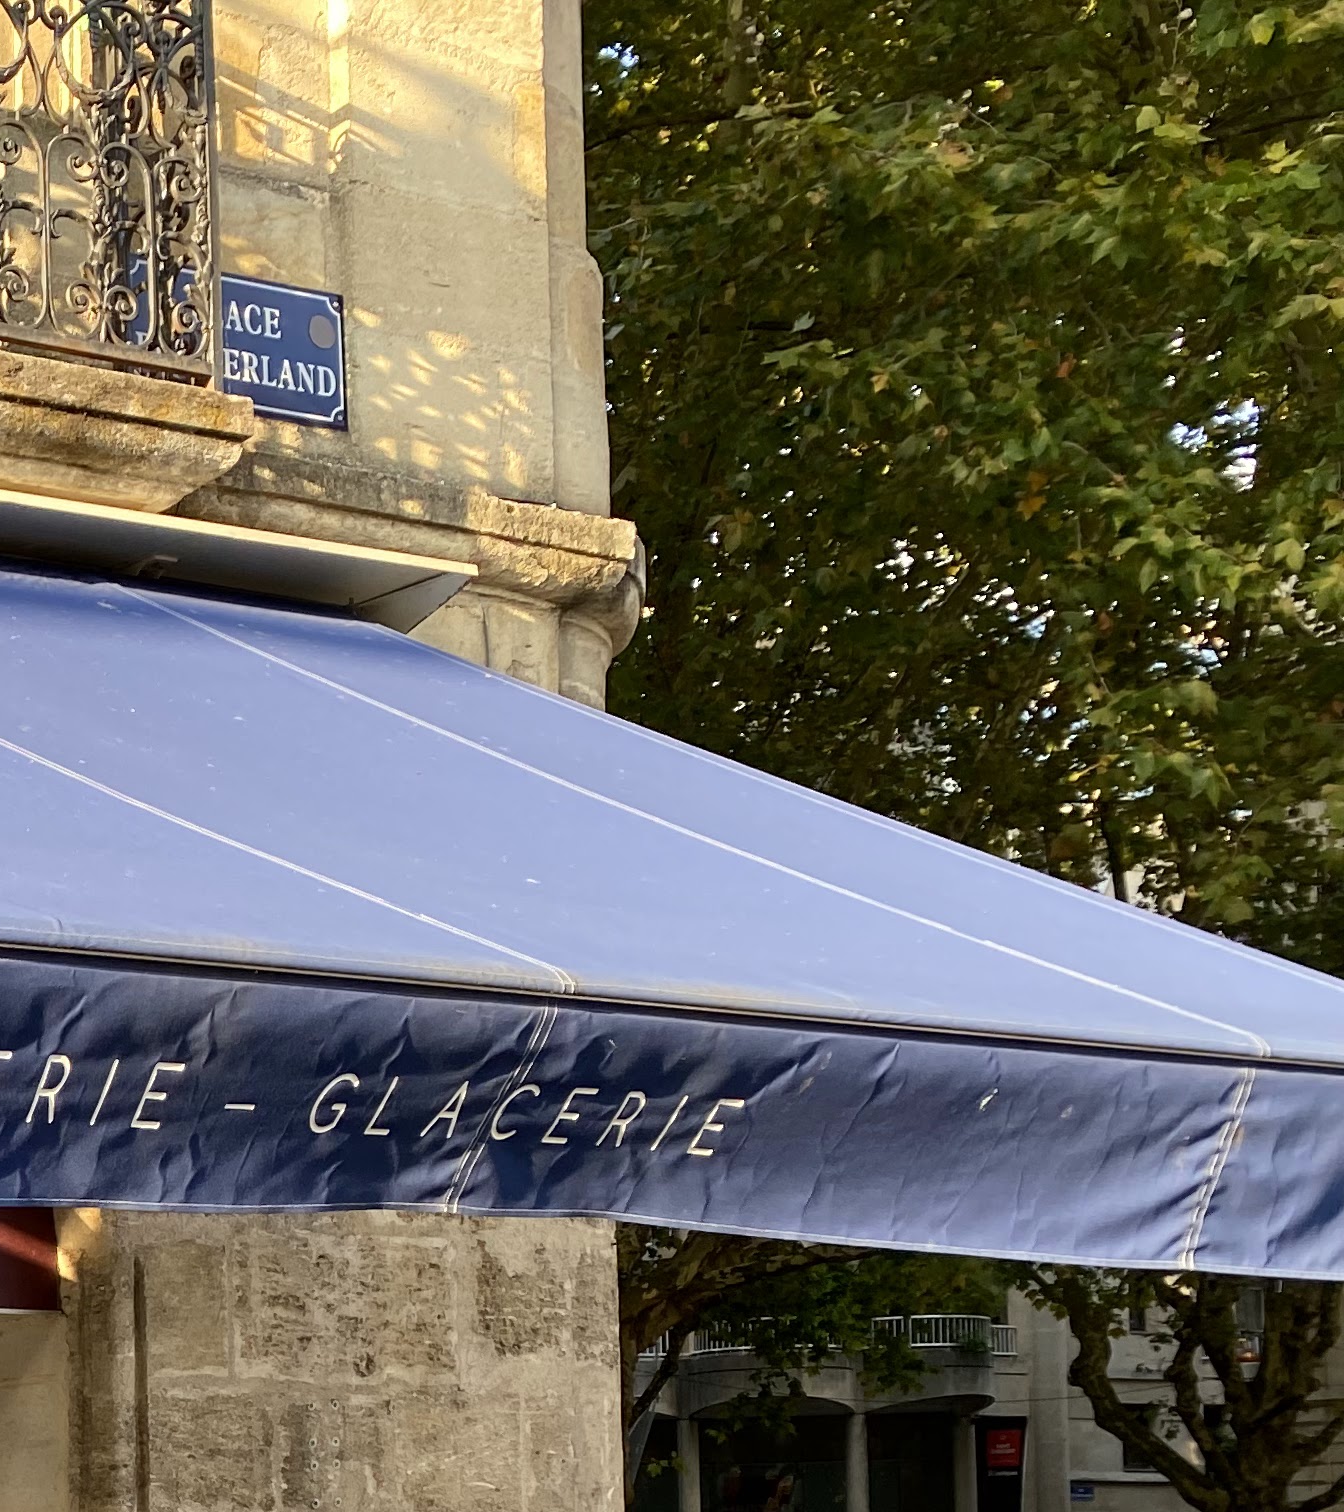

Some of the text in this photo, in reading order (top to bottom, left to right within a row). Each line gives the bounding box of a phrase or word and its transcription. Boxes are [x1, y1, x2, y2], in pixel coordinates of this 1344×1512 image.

[224, 300, 282, 340] ACE
[223, 348, 337, 397] ERLAND
[309, 1073, 745, 1157] GLACERIE
